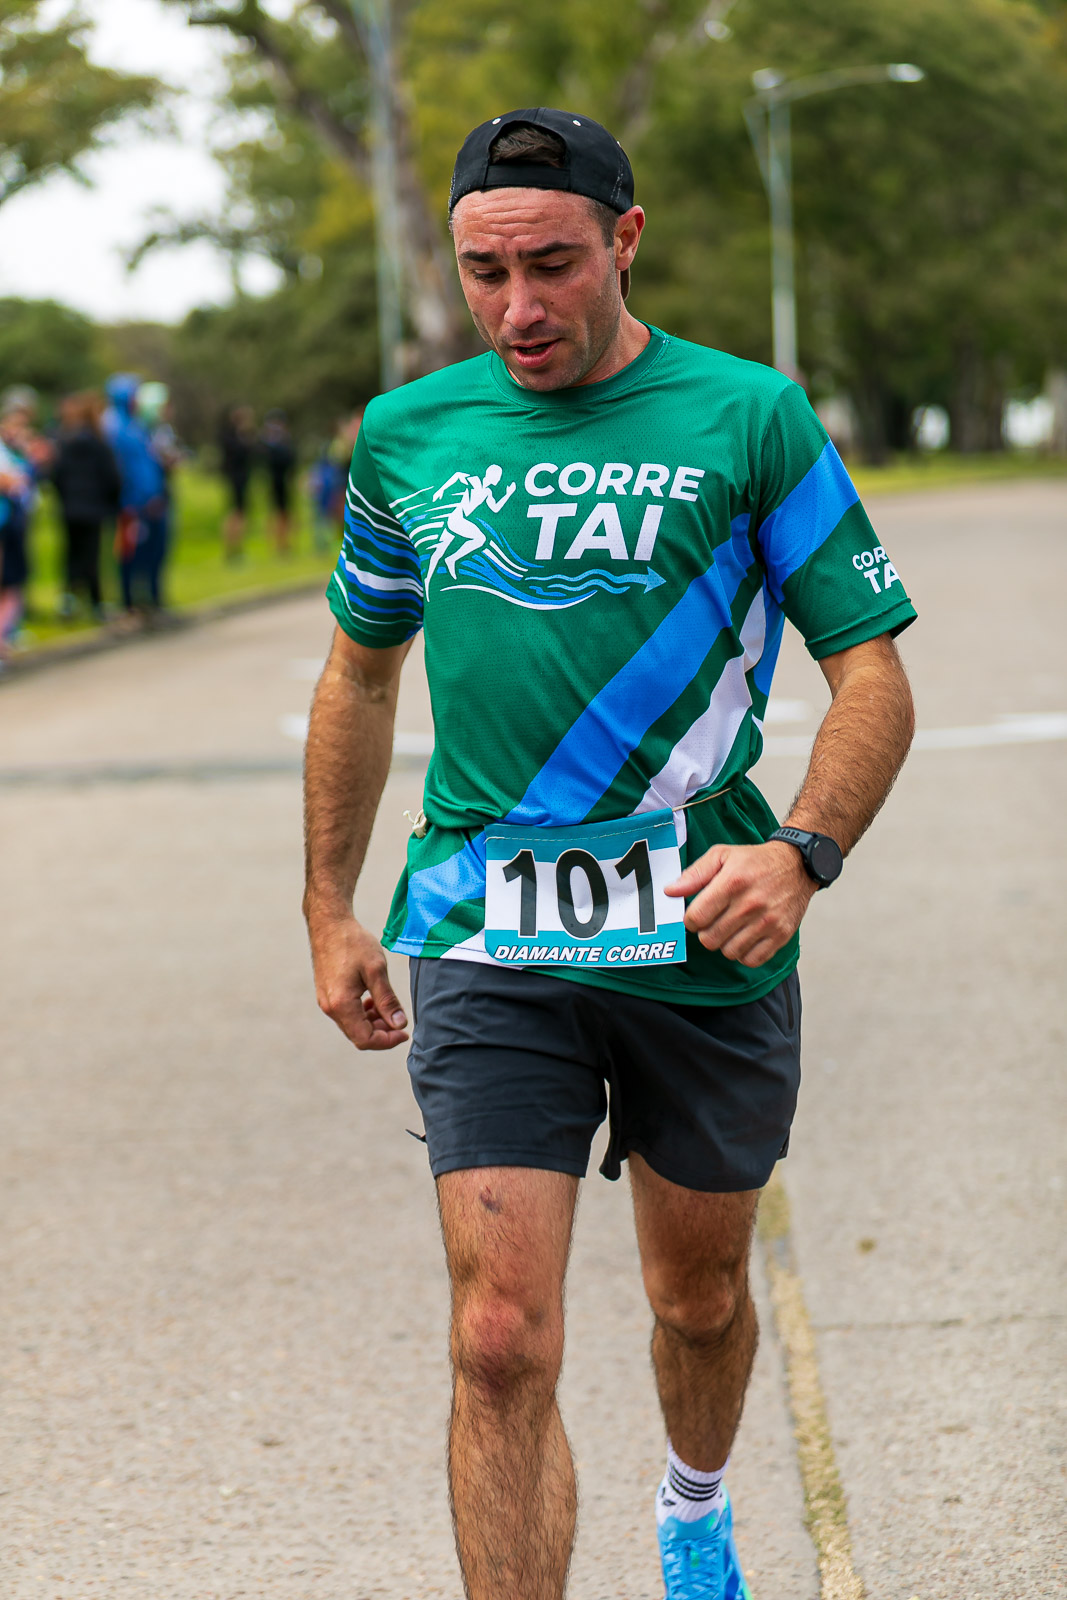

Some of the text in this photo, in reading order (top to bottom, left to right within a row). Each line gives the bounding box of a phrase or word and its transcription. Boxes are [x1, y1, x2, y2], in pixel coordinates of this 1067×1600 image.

[524, 462, 705, 502] CORRE
[526, 503, 664, 561] TAI
[852, 546, 888, 570] COR
[863, 562, 900, 594] TA
[502, 838, 657, 940] 101
[494, 941, 677, 962] DIAMANTE CORRE
